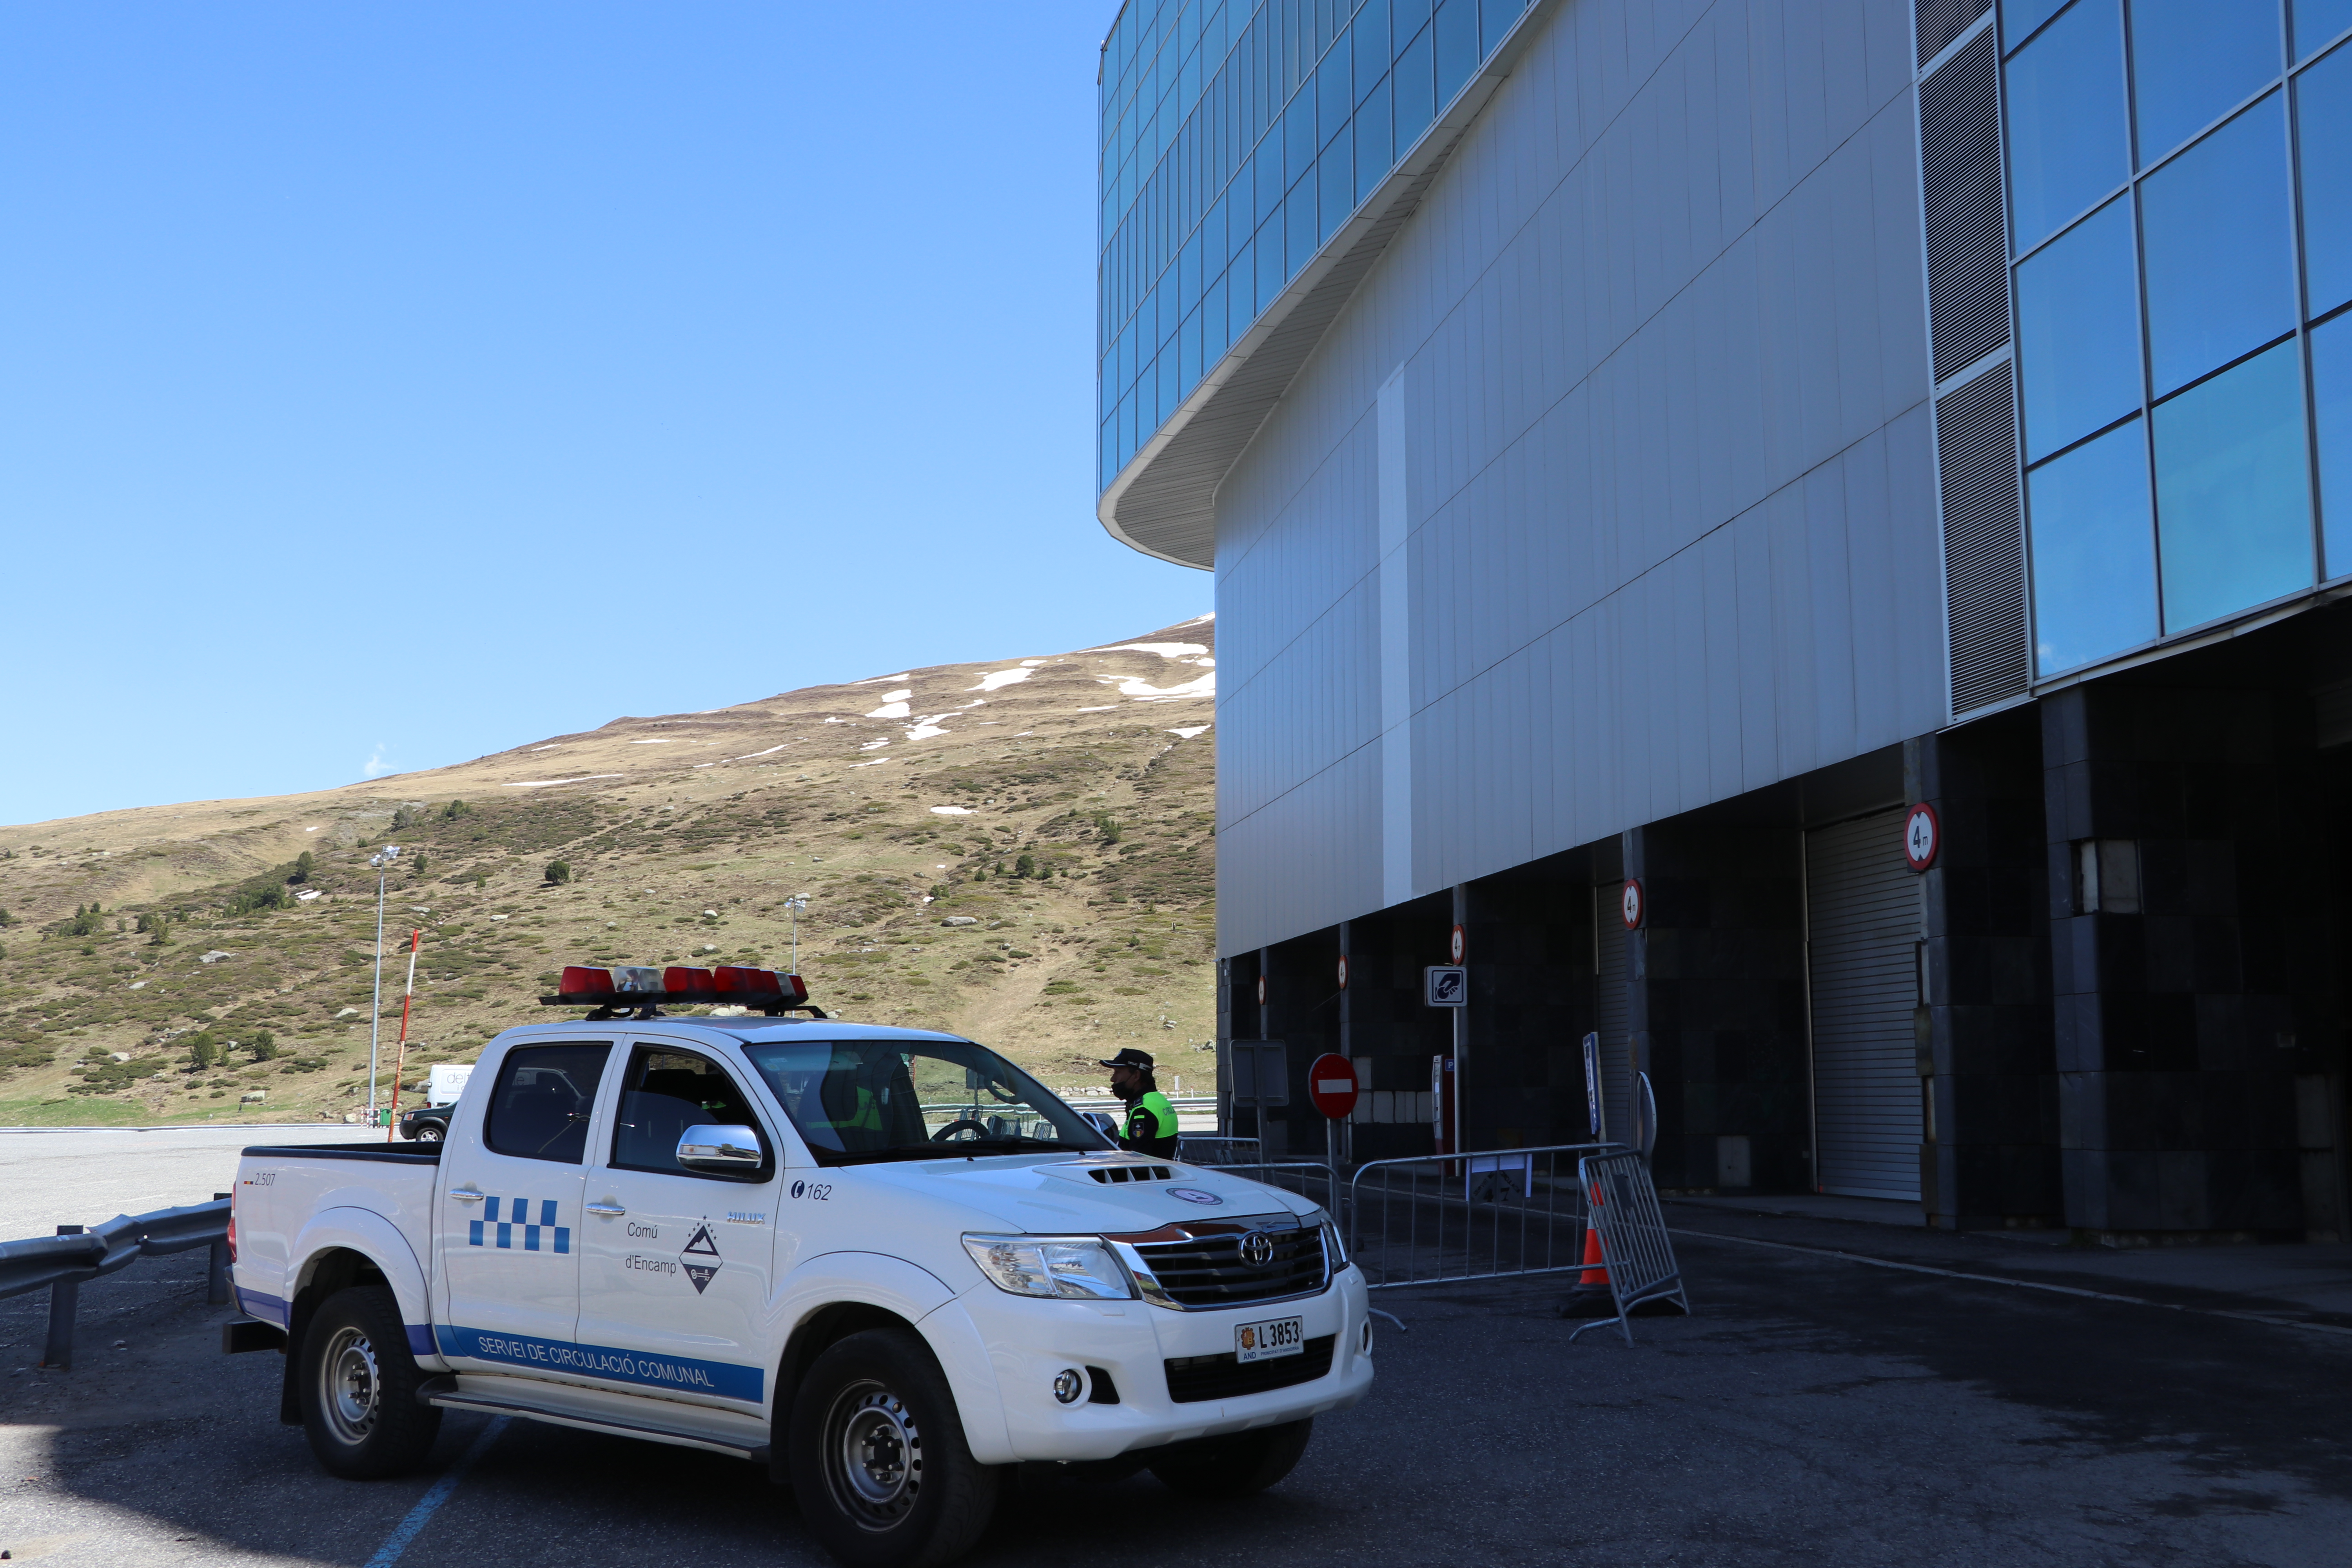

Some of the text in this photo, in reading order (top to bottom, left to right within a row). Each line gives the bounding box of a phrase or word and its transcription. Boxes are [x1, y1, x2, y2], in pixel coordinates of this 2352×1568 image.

[447, 1072, 470, 1084] delt
[255, 1172, 276, 1186] 2.507
[806, 1183, 832, 1201] 162
[727, 1211, 766, 1225] HILUX
[627, 1221, 658, 1239] Comú
[625, 1254, 677, 1277] d'Encamp
[1258, 1321, 1299, 1348] L 3853
[478, 1336, 715, 1388] SERVEI DE CIRCULACIÓ COMUNAL
[1243, 1351, 1256, 1361] AND
